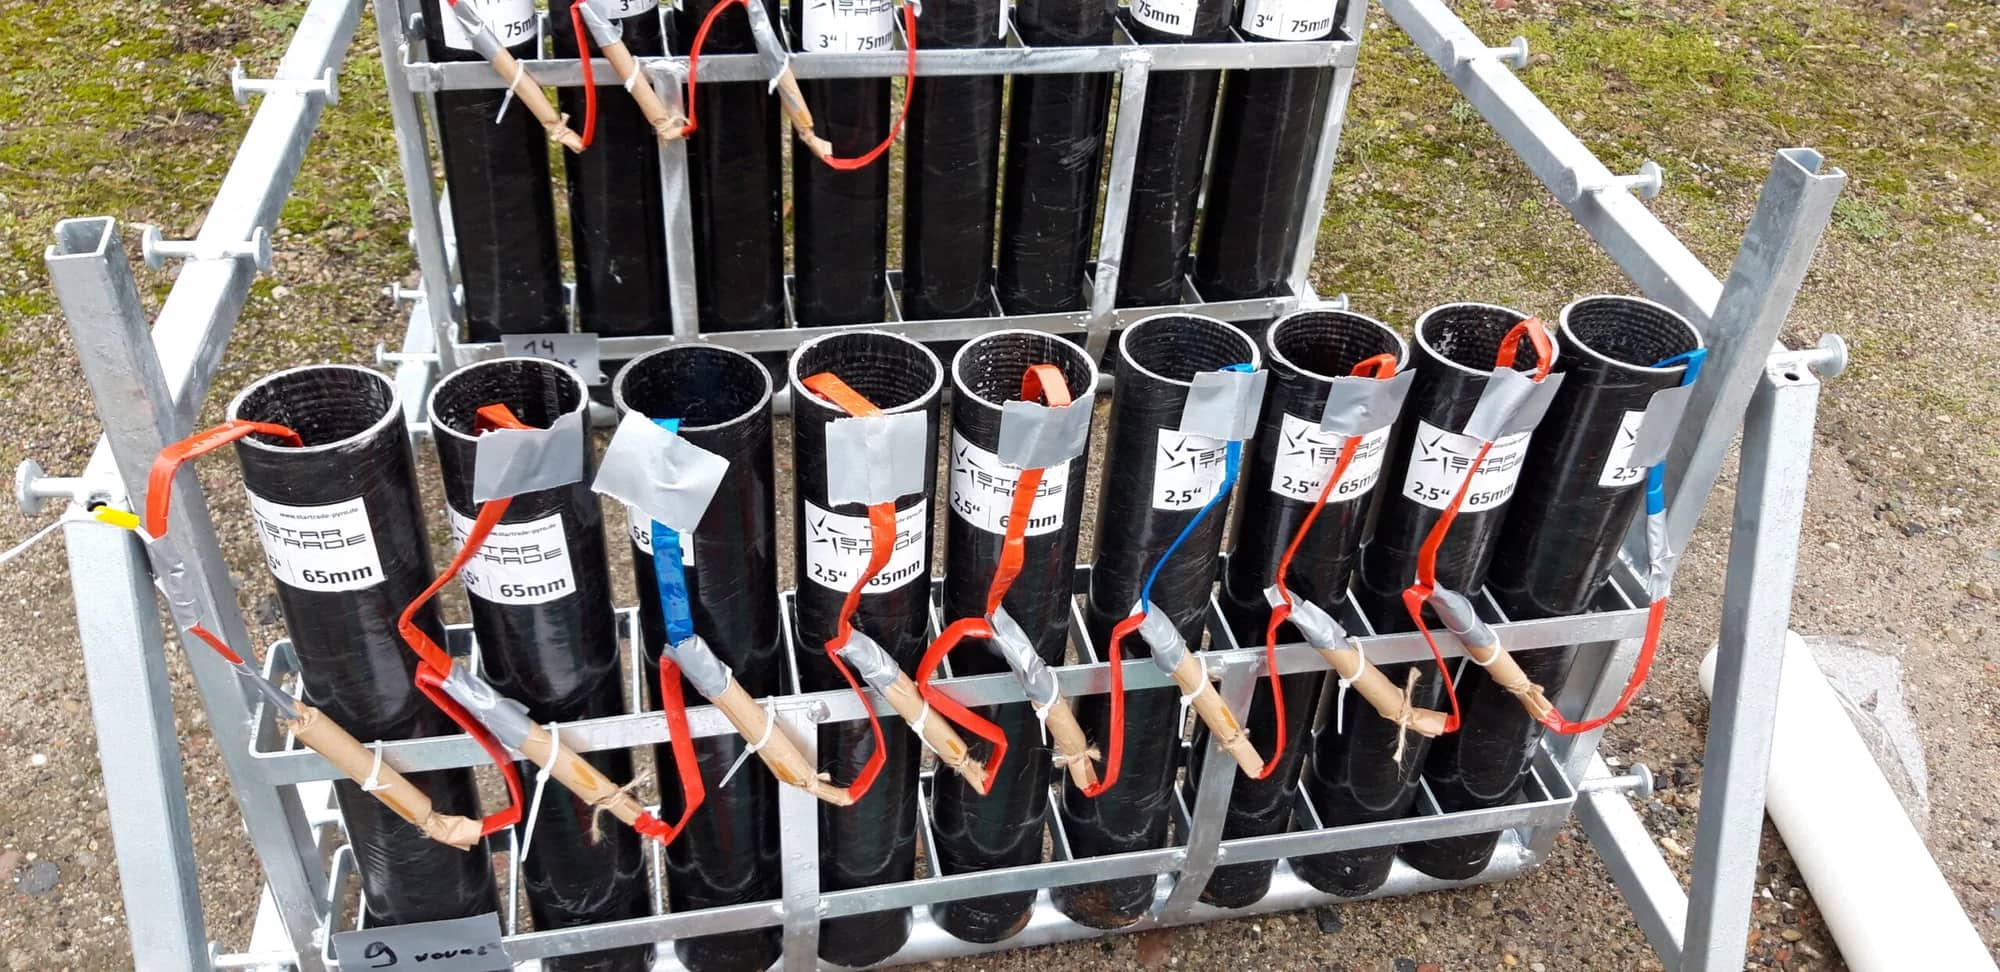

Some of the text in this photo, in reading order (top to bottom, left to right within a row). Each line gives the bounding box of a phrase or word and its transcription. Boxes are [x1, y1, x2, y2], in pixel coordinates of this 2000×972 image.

[1291, 17, 1330, 33] 75mm
[857, 31, 892, 51] 75mm
[523, 339, 555, 354] 14
[1338, 467, 1380, 495] 65mm
[1468, 482, 1514, 506] 65mm
[264, 521, 342, 540] STAR
[267, 531, 367, 550] TRADE
[302, 565, 373, 584] 65mm
[500, 578, 566, 598] 65mm
[364, 941, 398, 968] 9
